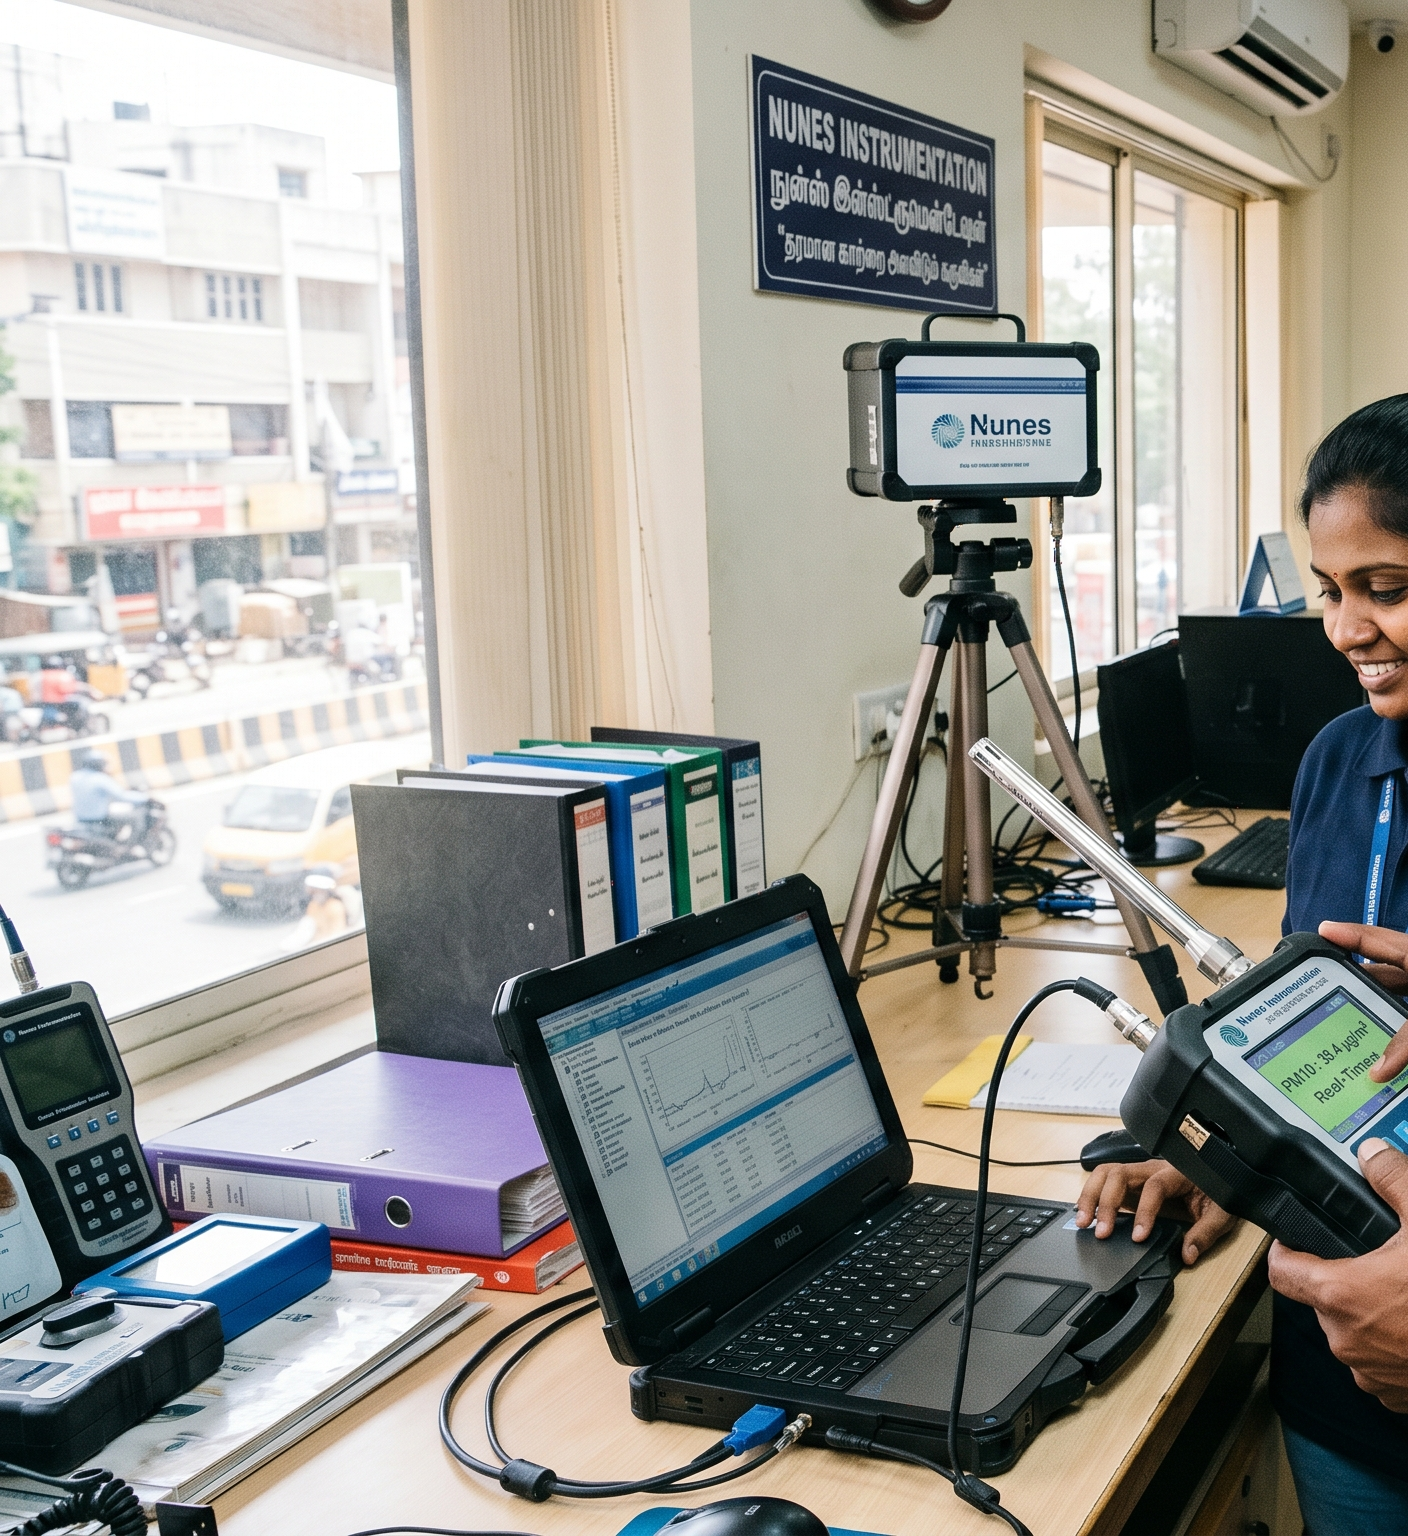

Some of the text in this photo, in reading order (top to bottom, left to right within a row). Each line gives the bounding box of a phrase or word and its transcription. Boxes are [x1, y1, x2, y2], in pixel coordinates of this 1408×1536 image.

[767, 94, 988, 198] NUNES INSTRUMENTATION
[838, 238, 886, 279] காற்றை
[887, 249, 940, 286] அளவிடும்
[970, 413, 1052, 436] Nunes
